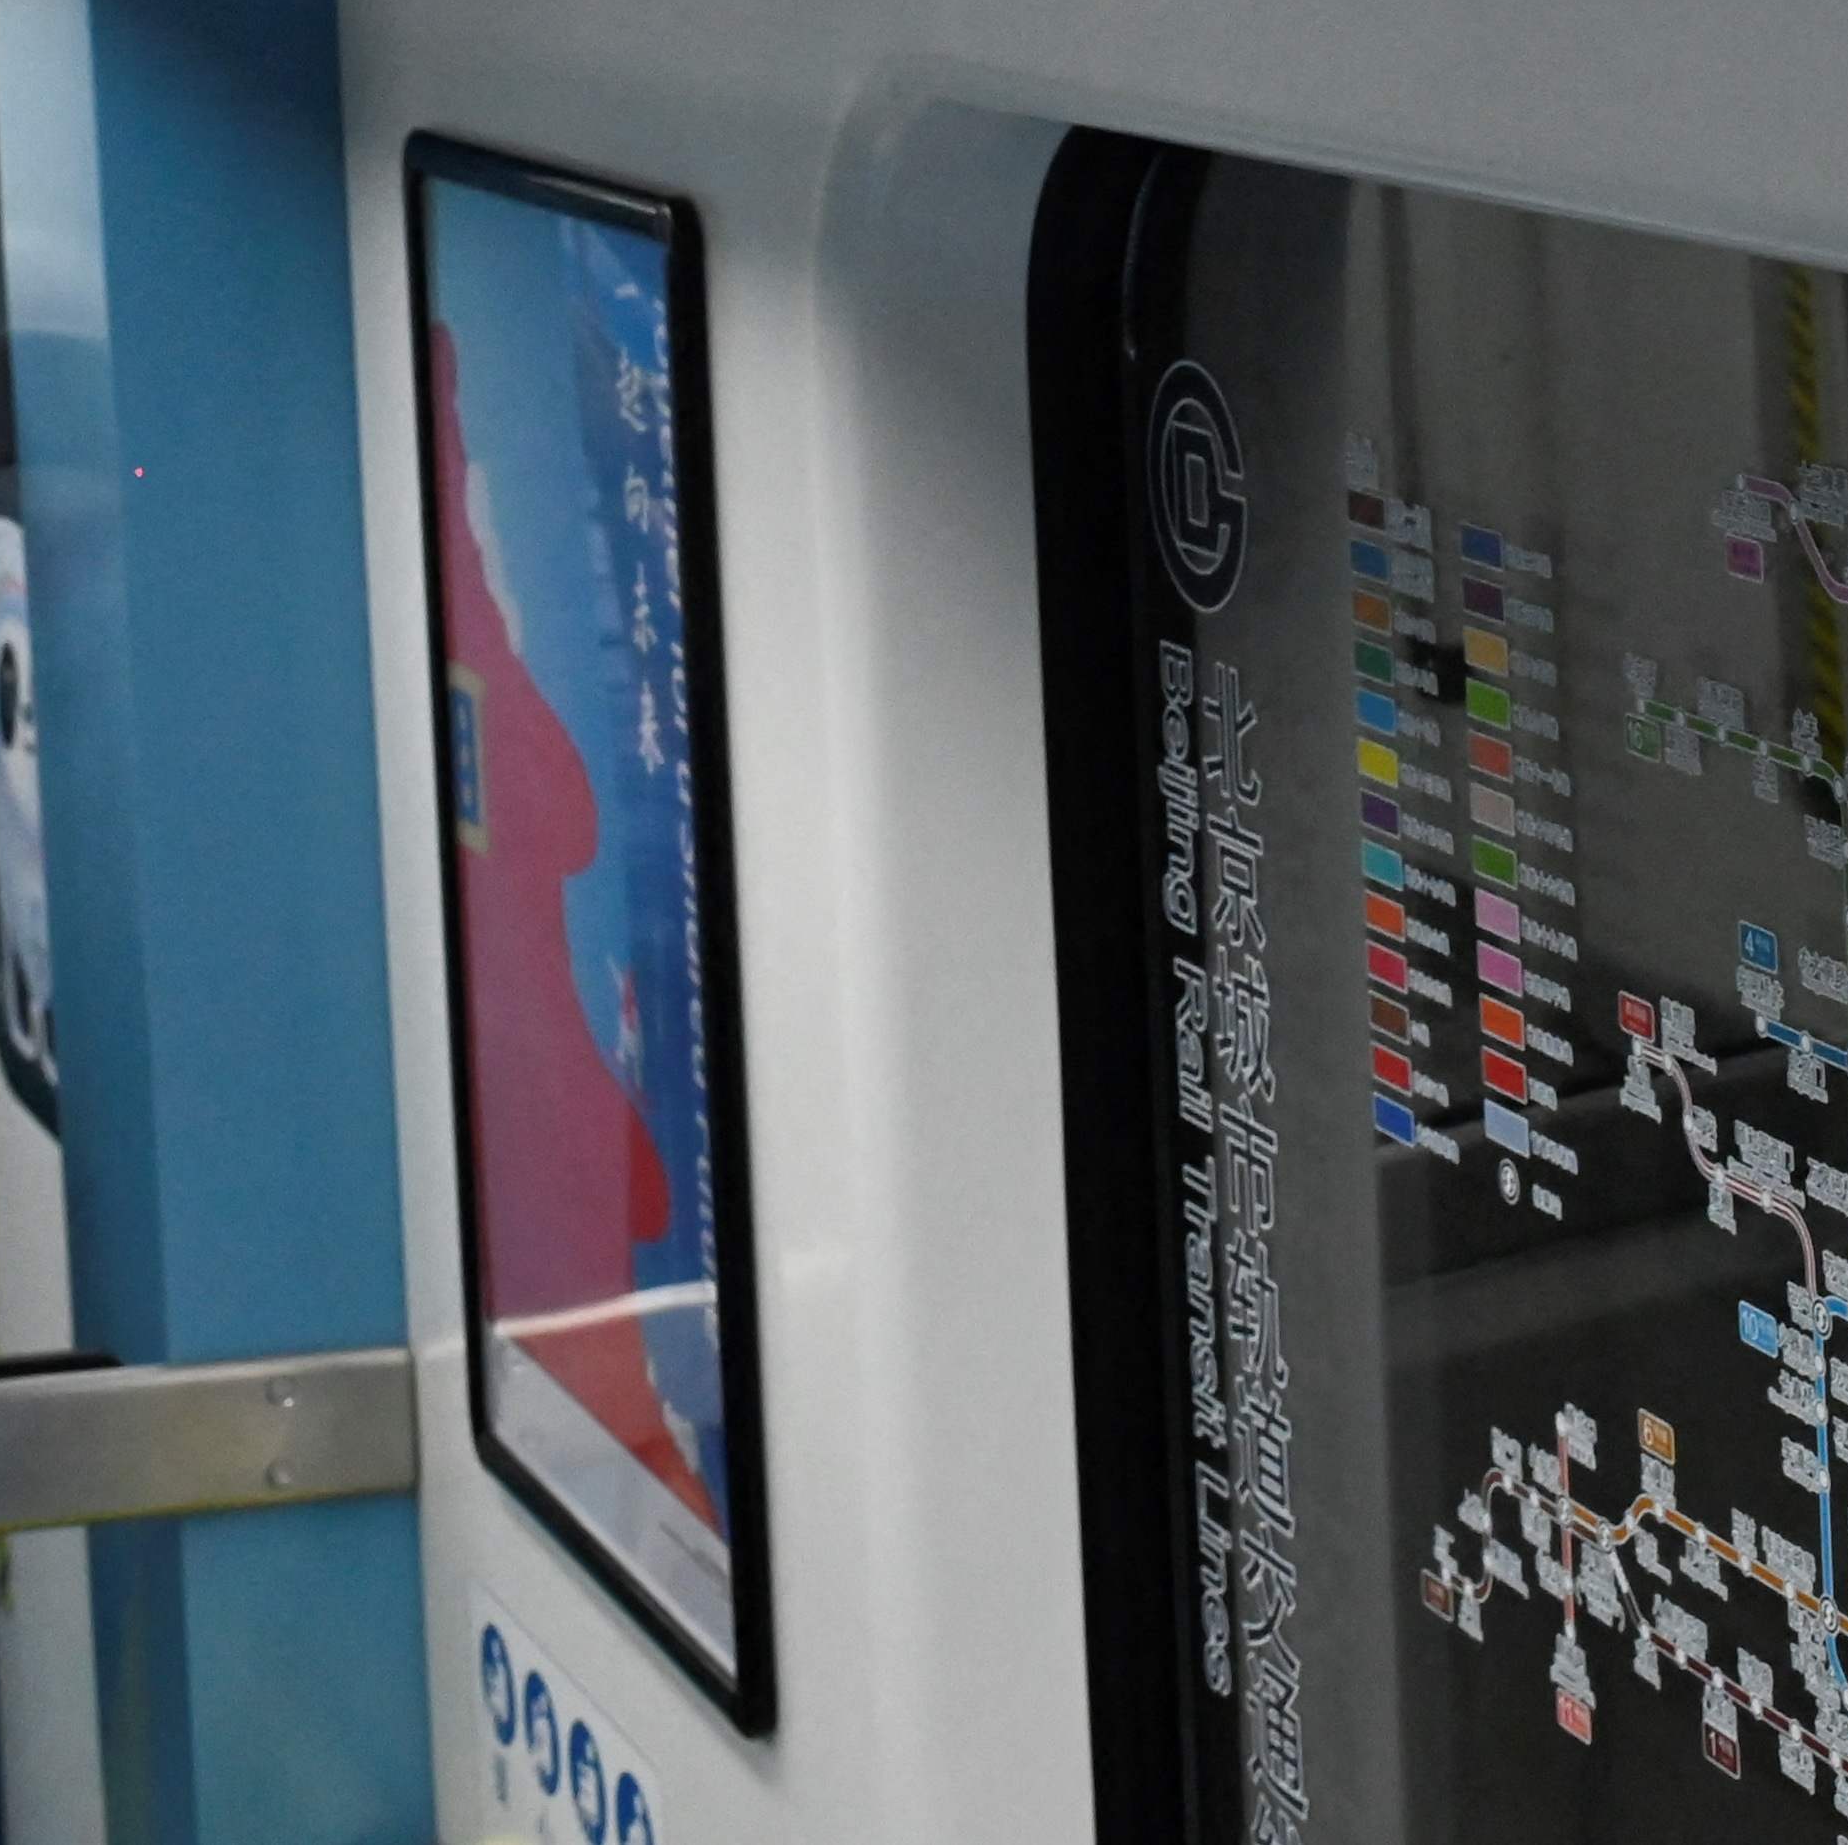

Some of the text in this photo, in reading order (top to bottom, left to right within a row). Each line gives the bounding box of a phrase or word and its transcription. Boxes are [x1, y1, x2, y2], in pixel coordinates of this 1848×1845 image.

[1157, 638, 1233, 1698] Beijing Rail Transit Lines
